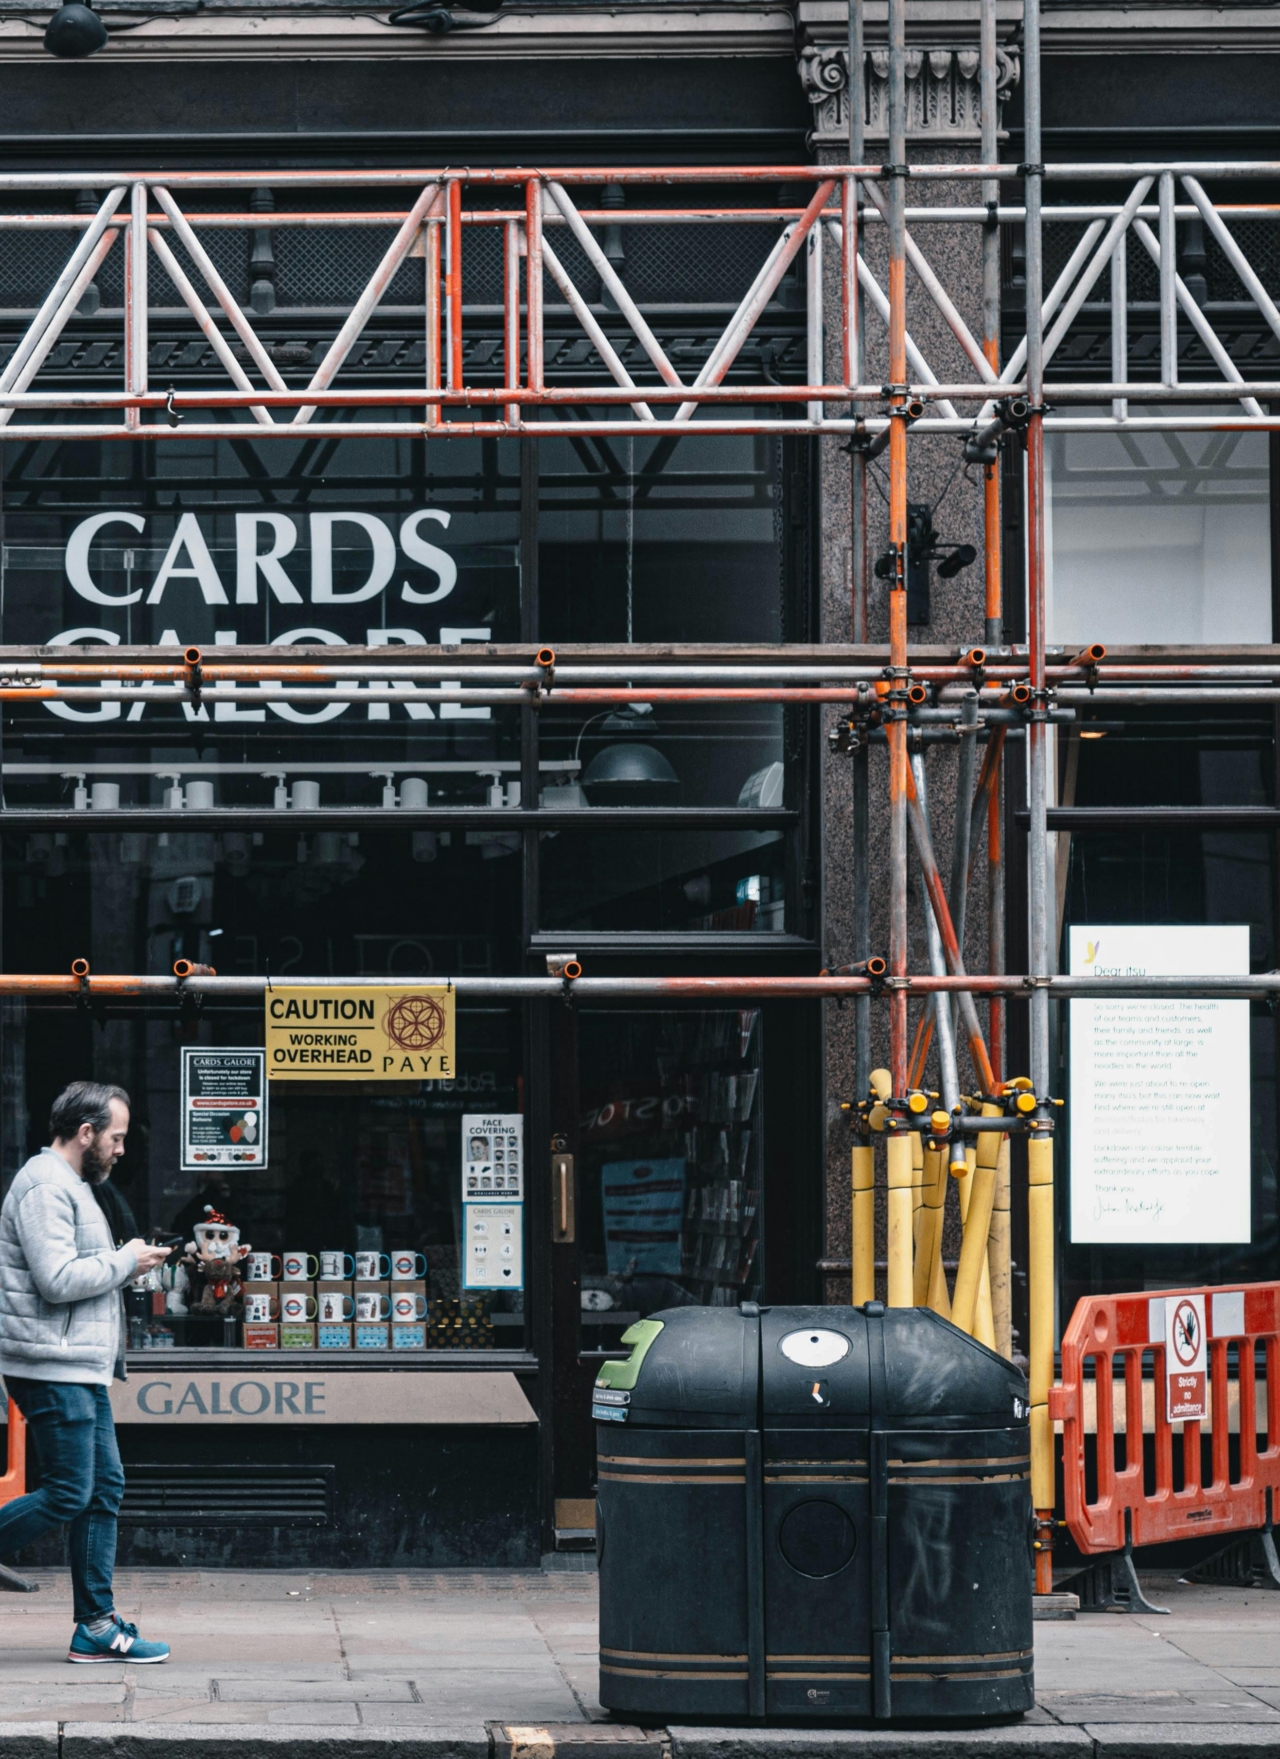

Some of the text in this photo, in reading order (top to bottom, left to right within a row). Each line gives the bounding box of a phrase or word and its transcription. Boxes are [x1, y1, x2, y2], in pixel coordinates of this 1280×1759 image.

[64, 508, 459, 606] CARDS
[1094, 965, 1146, 976] Dear itsu
[270, 999, 375, 1020] CAUTION
[289, 1034, 357, 1047] WORKING
[193, 1058, 256, 1066] CARDS GALORE
[273, 1048, 372, 1065] OVERHEAD
[383, 1054, 450, 1073] PAYE
[482, 1119, 502, 1127] FACE
[1178, 1377, 1197, 1388] Strictly
[137, 1381, 327, 1416] GALORE
[1183, 1391, 1192, 1400] no
[1173, 1404, 1202, 1414] admittance
[110, 1633, 135, 1654] N
